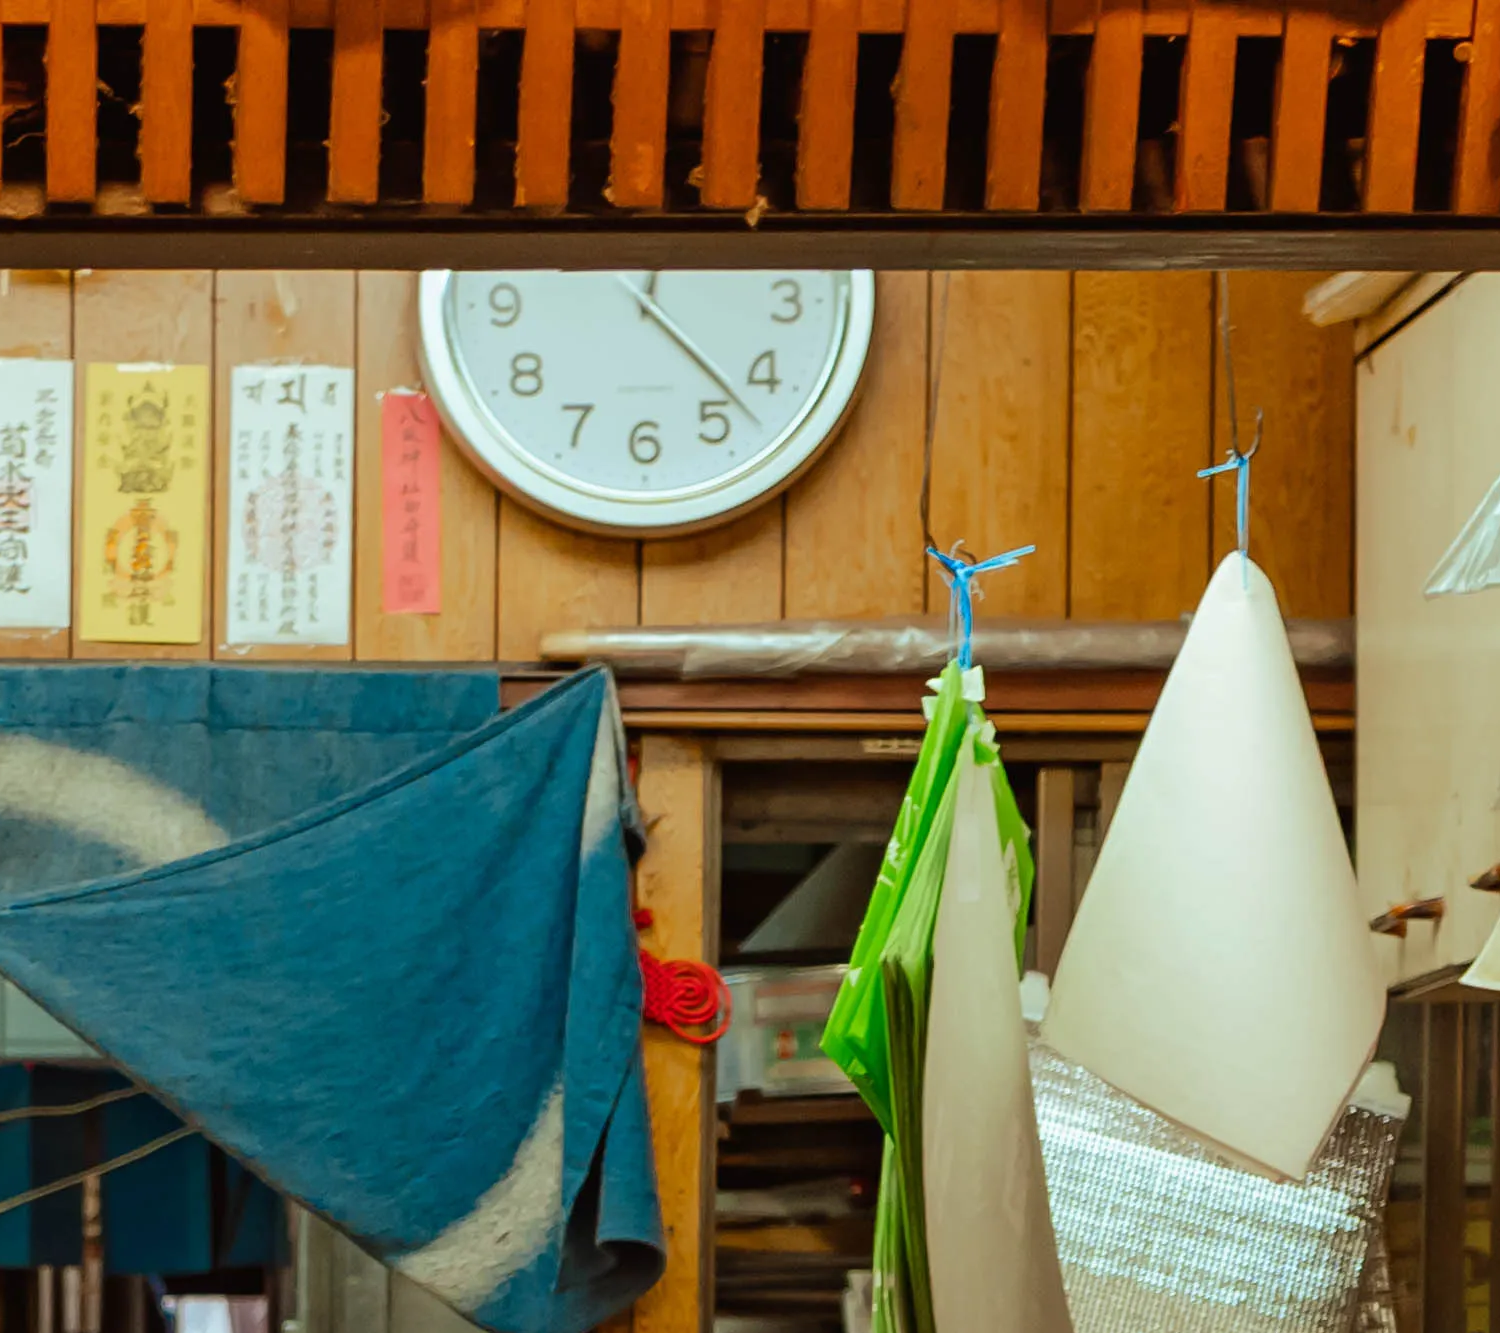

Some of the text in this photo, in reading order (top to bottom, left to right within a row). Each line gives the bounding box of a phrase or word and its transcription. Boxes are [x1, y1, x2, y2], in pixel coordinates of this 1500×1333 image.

[488, 282, 522, 327] 9
[770, 279, 802, 323] 3
[510, 352, 543, 396] 8
[747, 350, 781, 394] 4
[561, 404, 594, 448] 7
[629, 421, 661, 464] 6
[697, 400, 731, 444] 5
